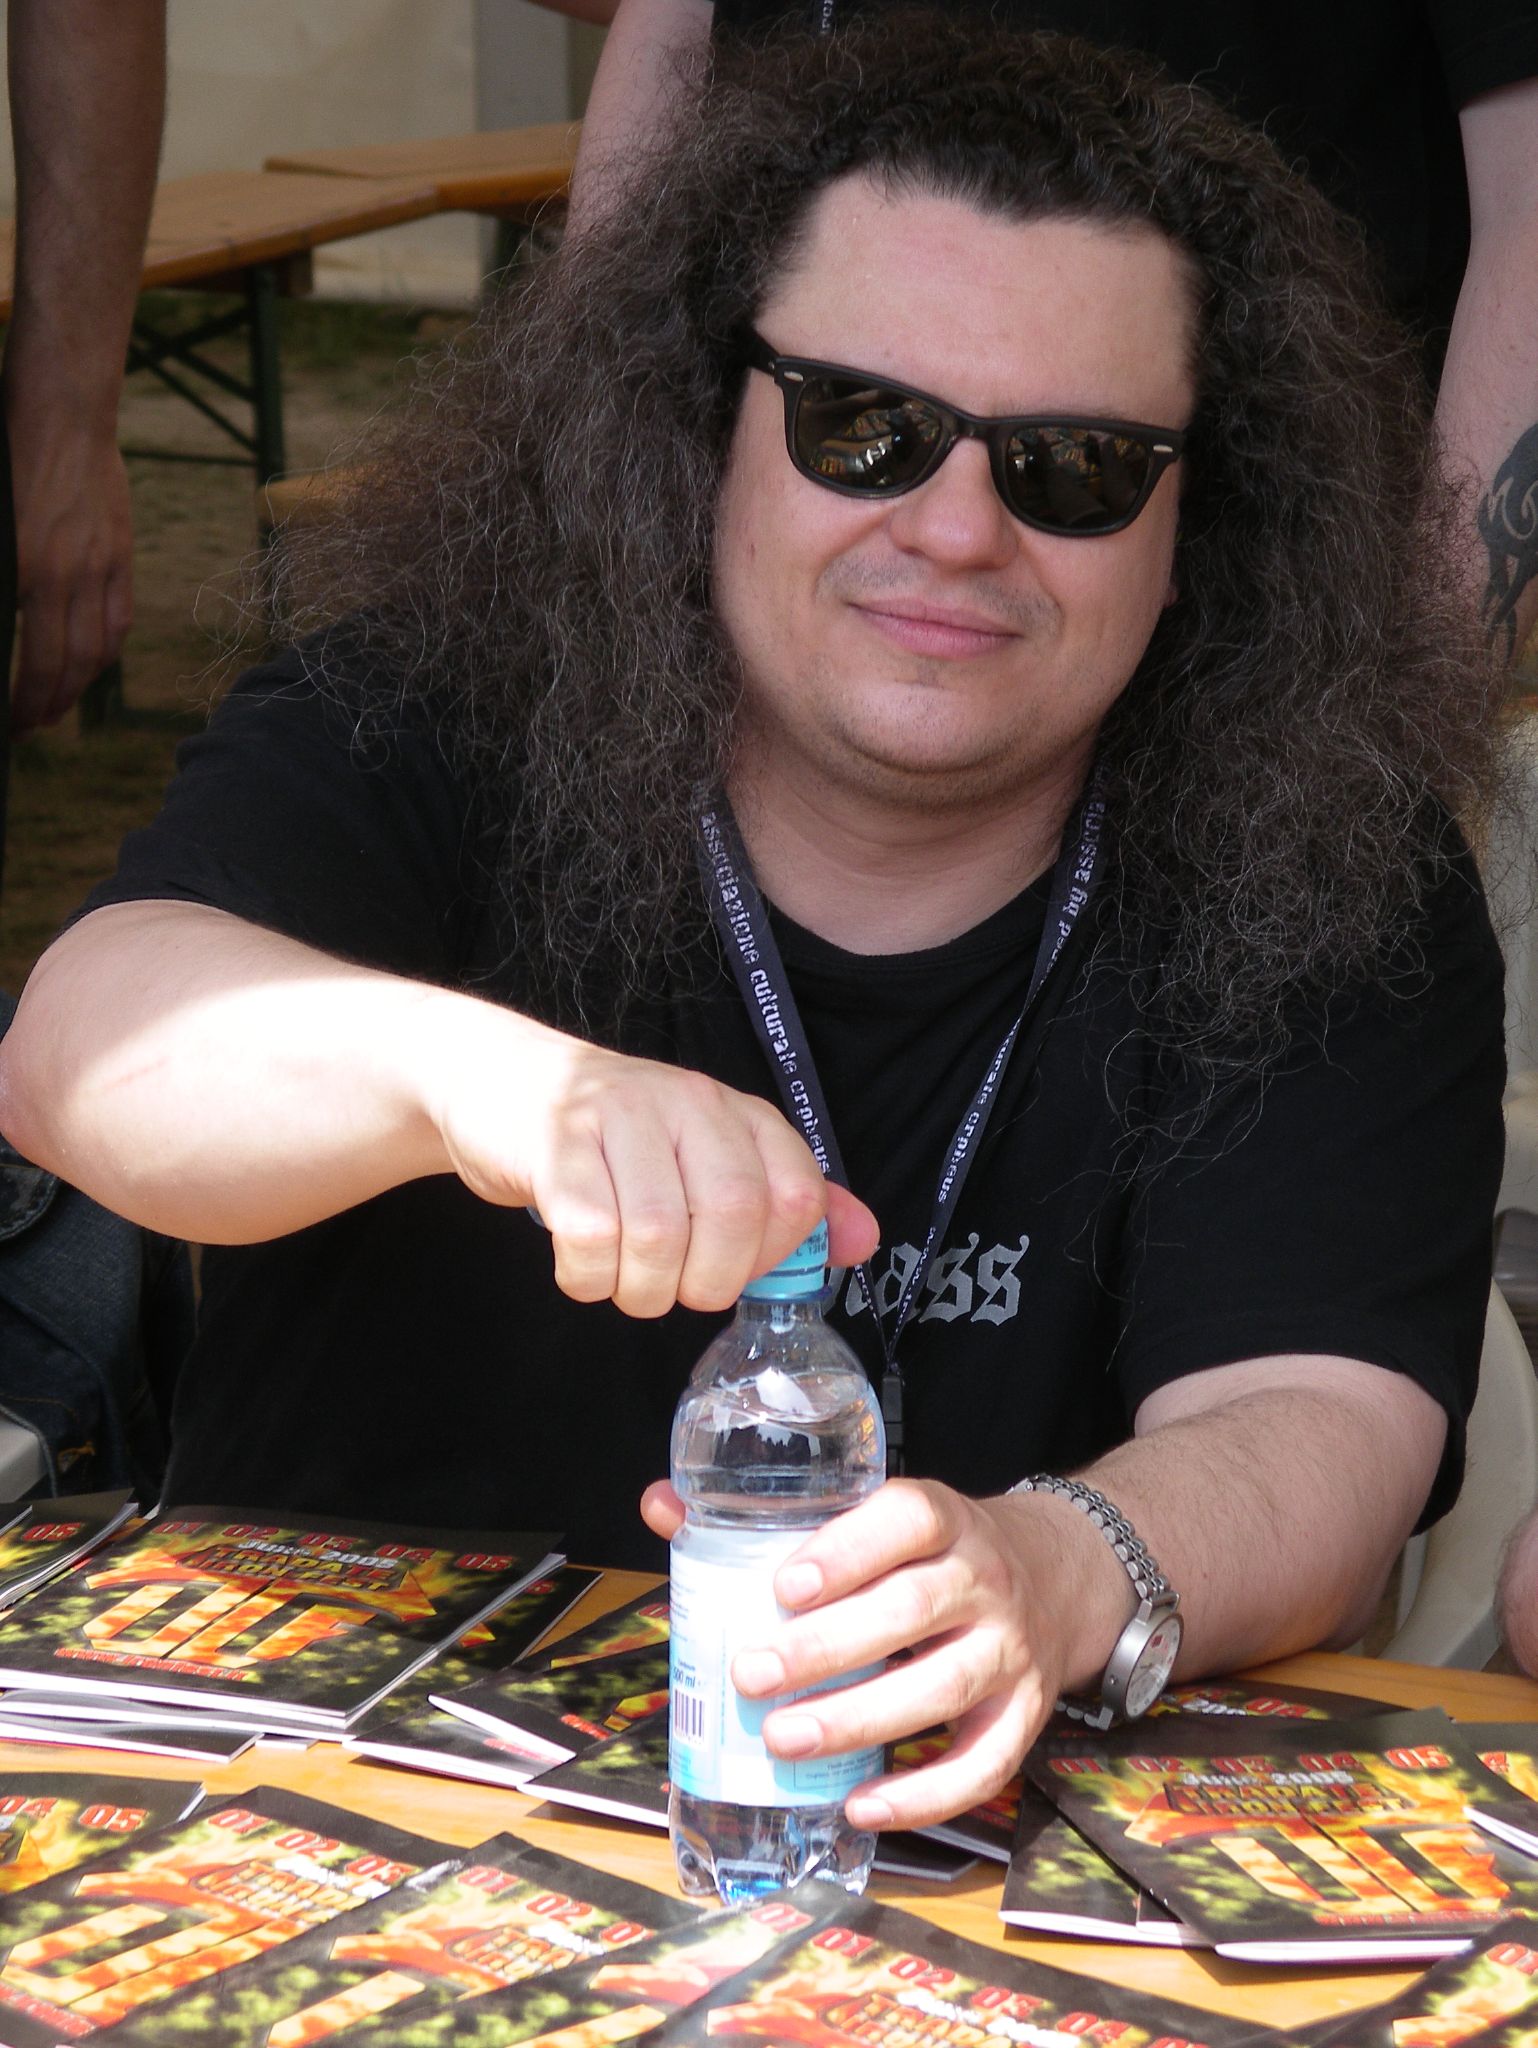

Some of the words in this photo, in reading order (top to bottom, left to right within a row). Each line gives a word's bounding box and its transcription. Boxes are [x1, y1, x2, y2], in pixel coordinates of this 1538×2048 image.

[751, 968, 798, 1075] culturale
[23, 1522, 84, 1541] 05
[152, 1521, 202, 1535] 01
[222, 1524, 280, 1541] 02
[376, 1543, 438, 1563] 04
[455, 1554, 513, 1571] 05
[1048, 1757, 1104, 1774] 01
[1124, 1755, 1186, 1773] 02
[1299, 1752, 1365, 1772] 04
[1384, 1745, 1452, 1769] 05
[79, 1804, 148, 1832] 05
[208, 1808, 271, 1835] 01
[275, 1830, 340, 1860] 02
[345, 1855, 416, 1885] 03
[458, 1866, 520, 1894] 01
[526, 1893, 593, 1925] 02
[751, 1903, 814, 1934] 01
[812, 1927, 875, 1958] 01
[889, 1957, 955, 1993] 02
[971, 1987, 1042, 2020] 03
[1055, 2012, 1130, 2044] 04
